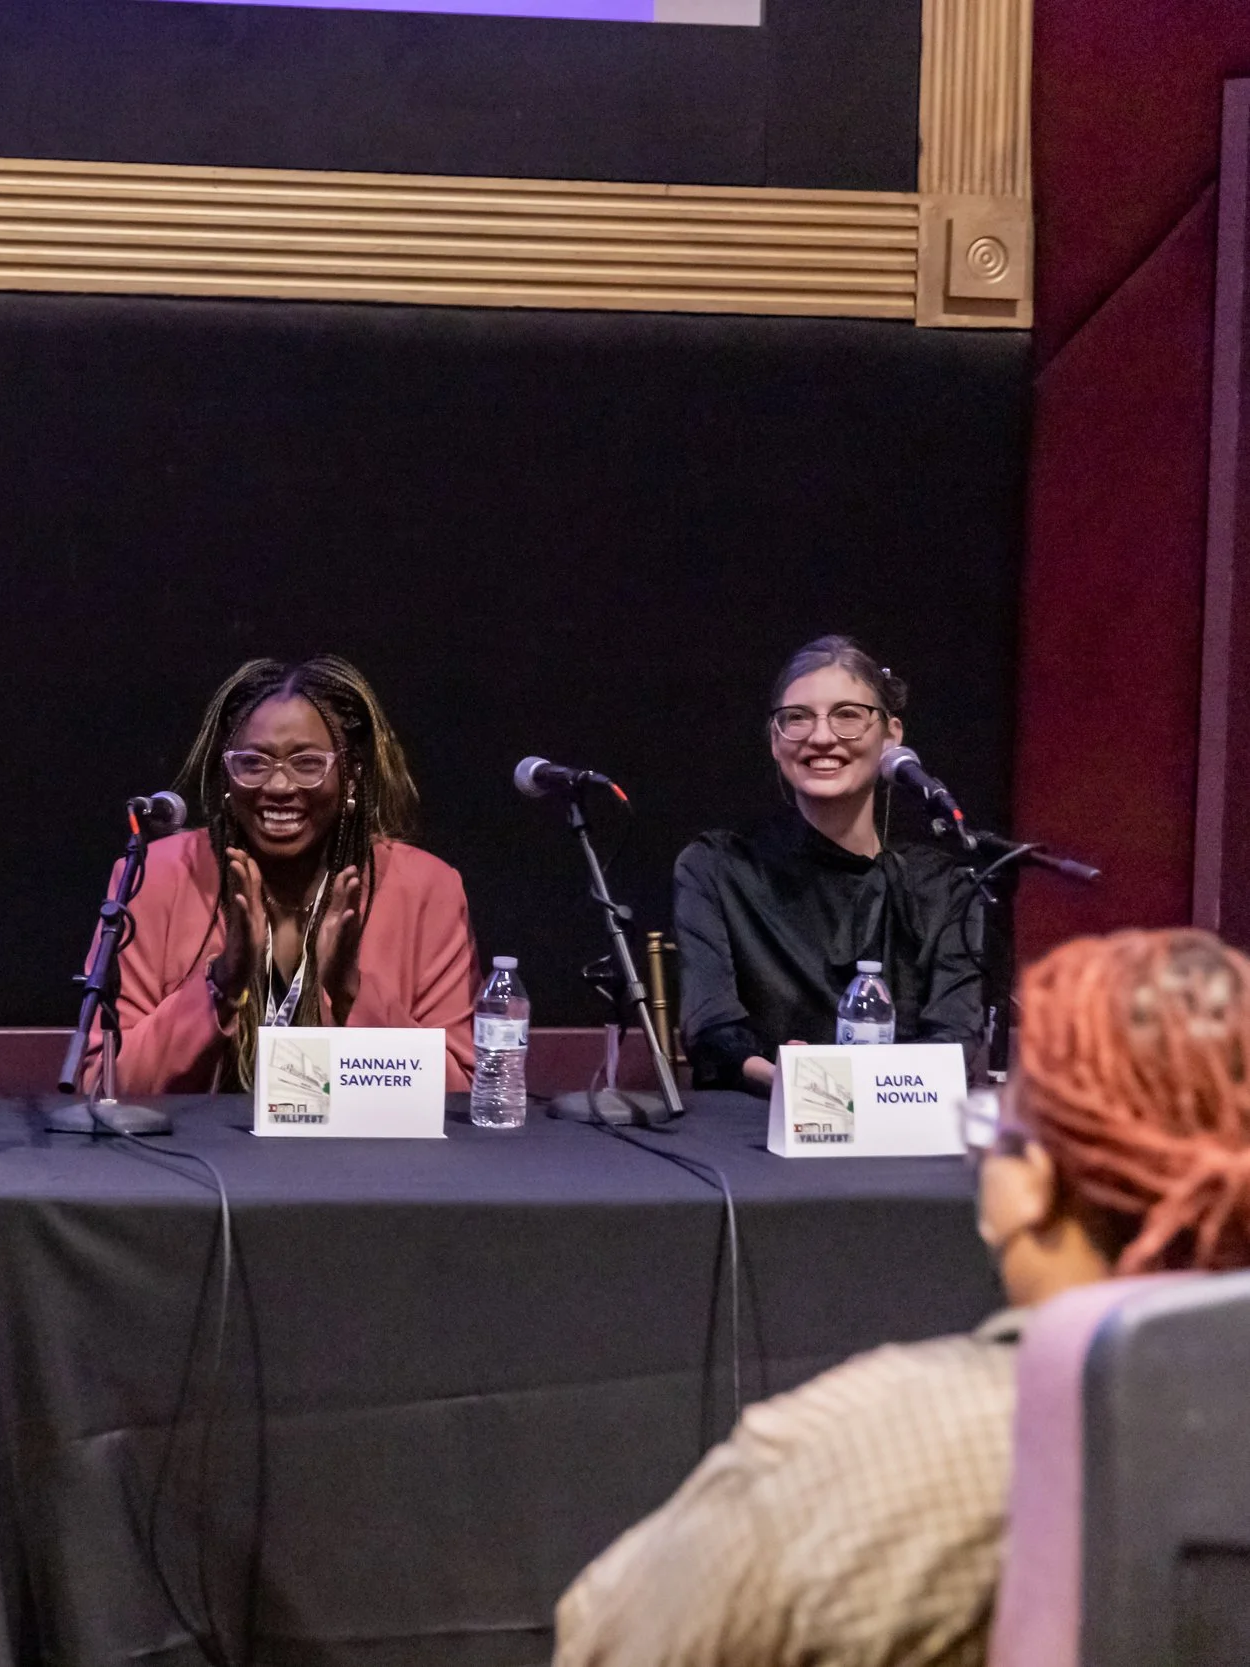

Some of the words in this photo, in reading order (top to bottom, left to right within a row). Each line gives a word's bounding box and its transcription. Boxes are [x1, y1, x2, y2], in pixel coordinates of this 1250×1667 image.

[340, 1058, 406, 1070] HANNAH
[410, 1059, 423, 1071] V.
[340, 1074, 412, 1087] SAWYERR
[876, 1075, 924, 1087] LAURA
[877, 1091, 938, 1103] NOWLIN
[274, 1114, 324, 1123] YALLFEST
[800, 1133, 849, 1143] YALLFEST
